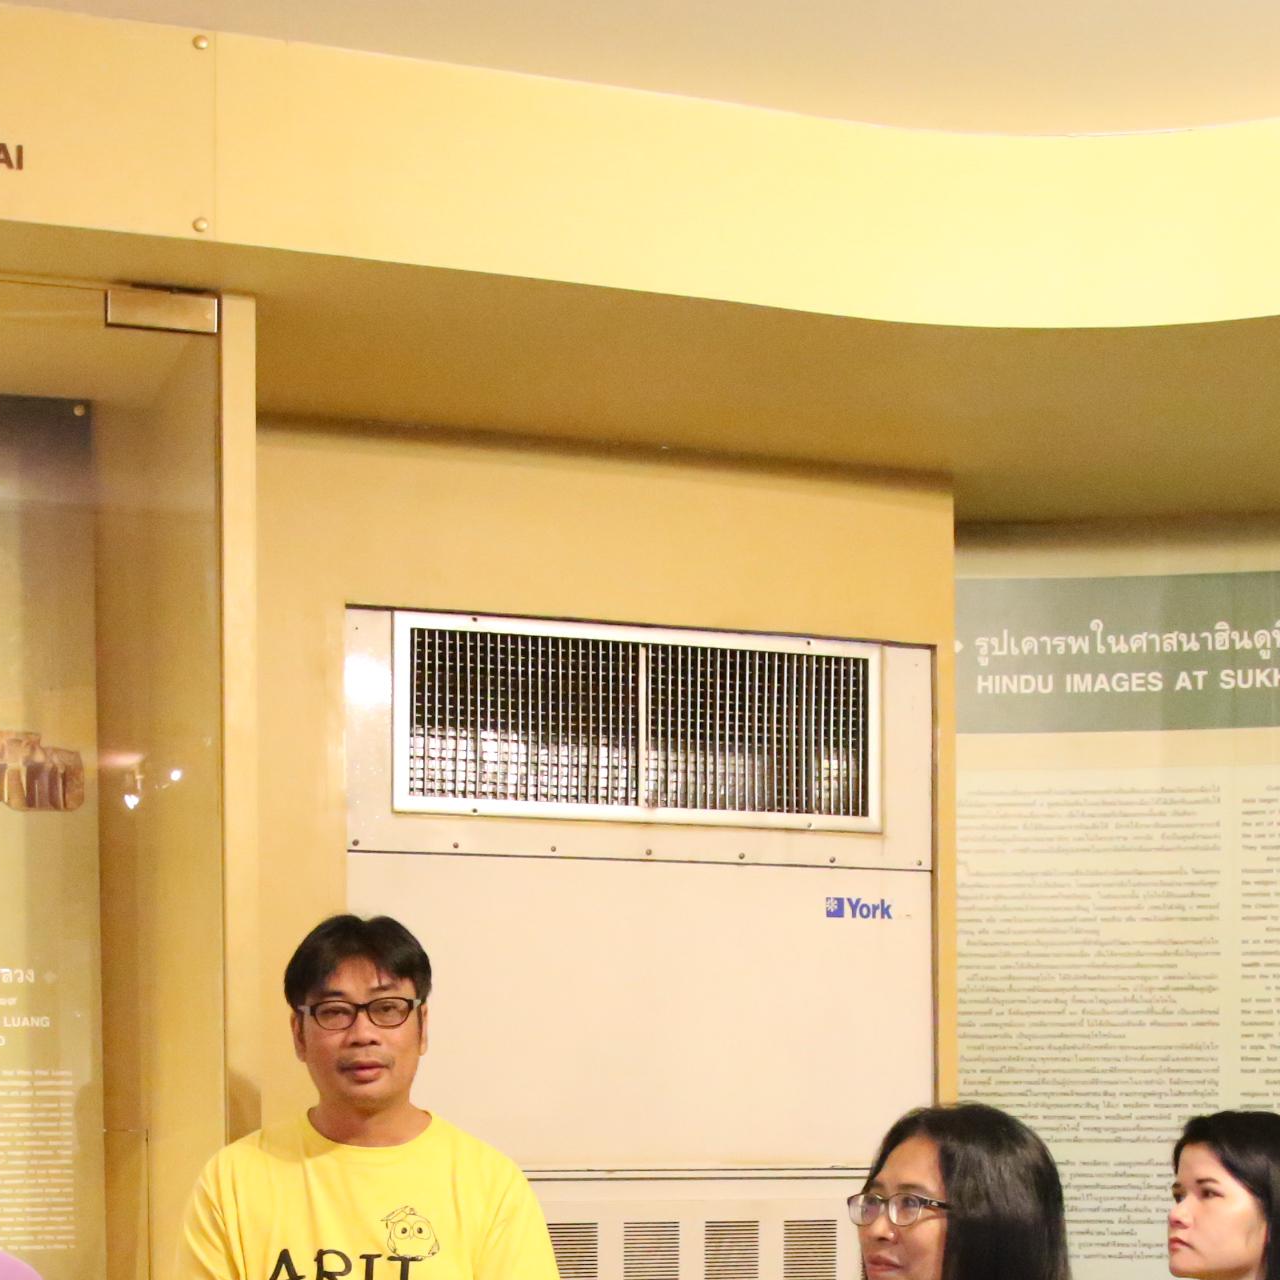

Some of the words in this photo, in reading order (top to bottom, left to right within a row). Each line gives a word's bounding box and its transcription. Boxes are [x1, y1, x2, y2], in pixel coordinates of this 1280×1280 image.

[977, 673, 1054, 694] HINDU
[1065, 672, 1163, 693] IMAGES
[1175, 670, 1208, 691] AT
[846, 897, 892, 919] York
[3, 1016, 50, 1028] LUANG
